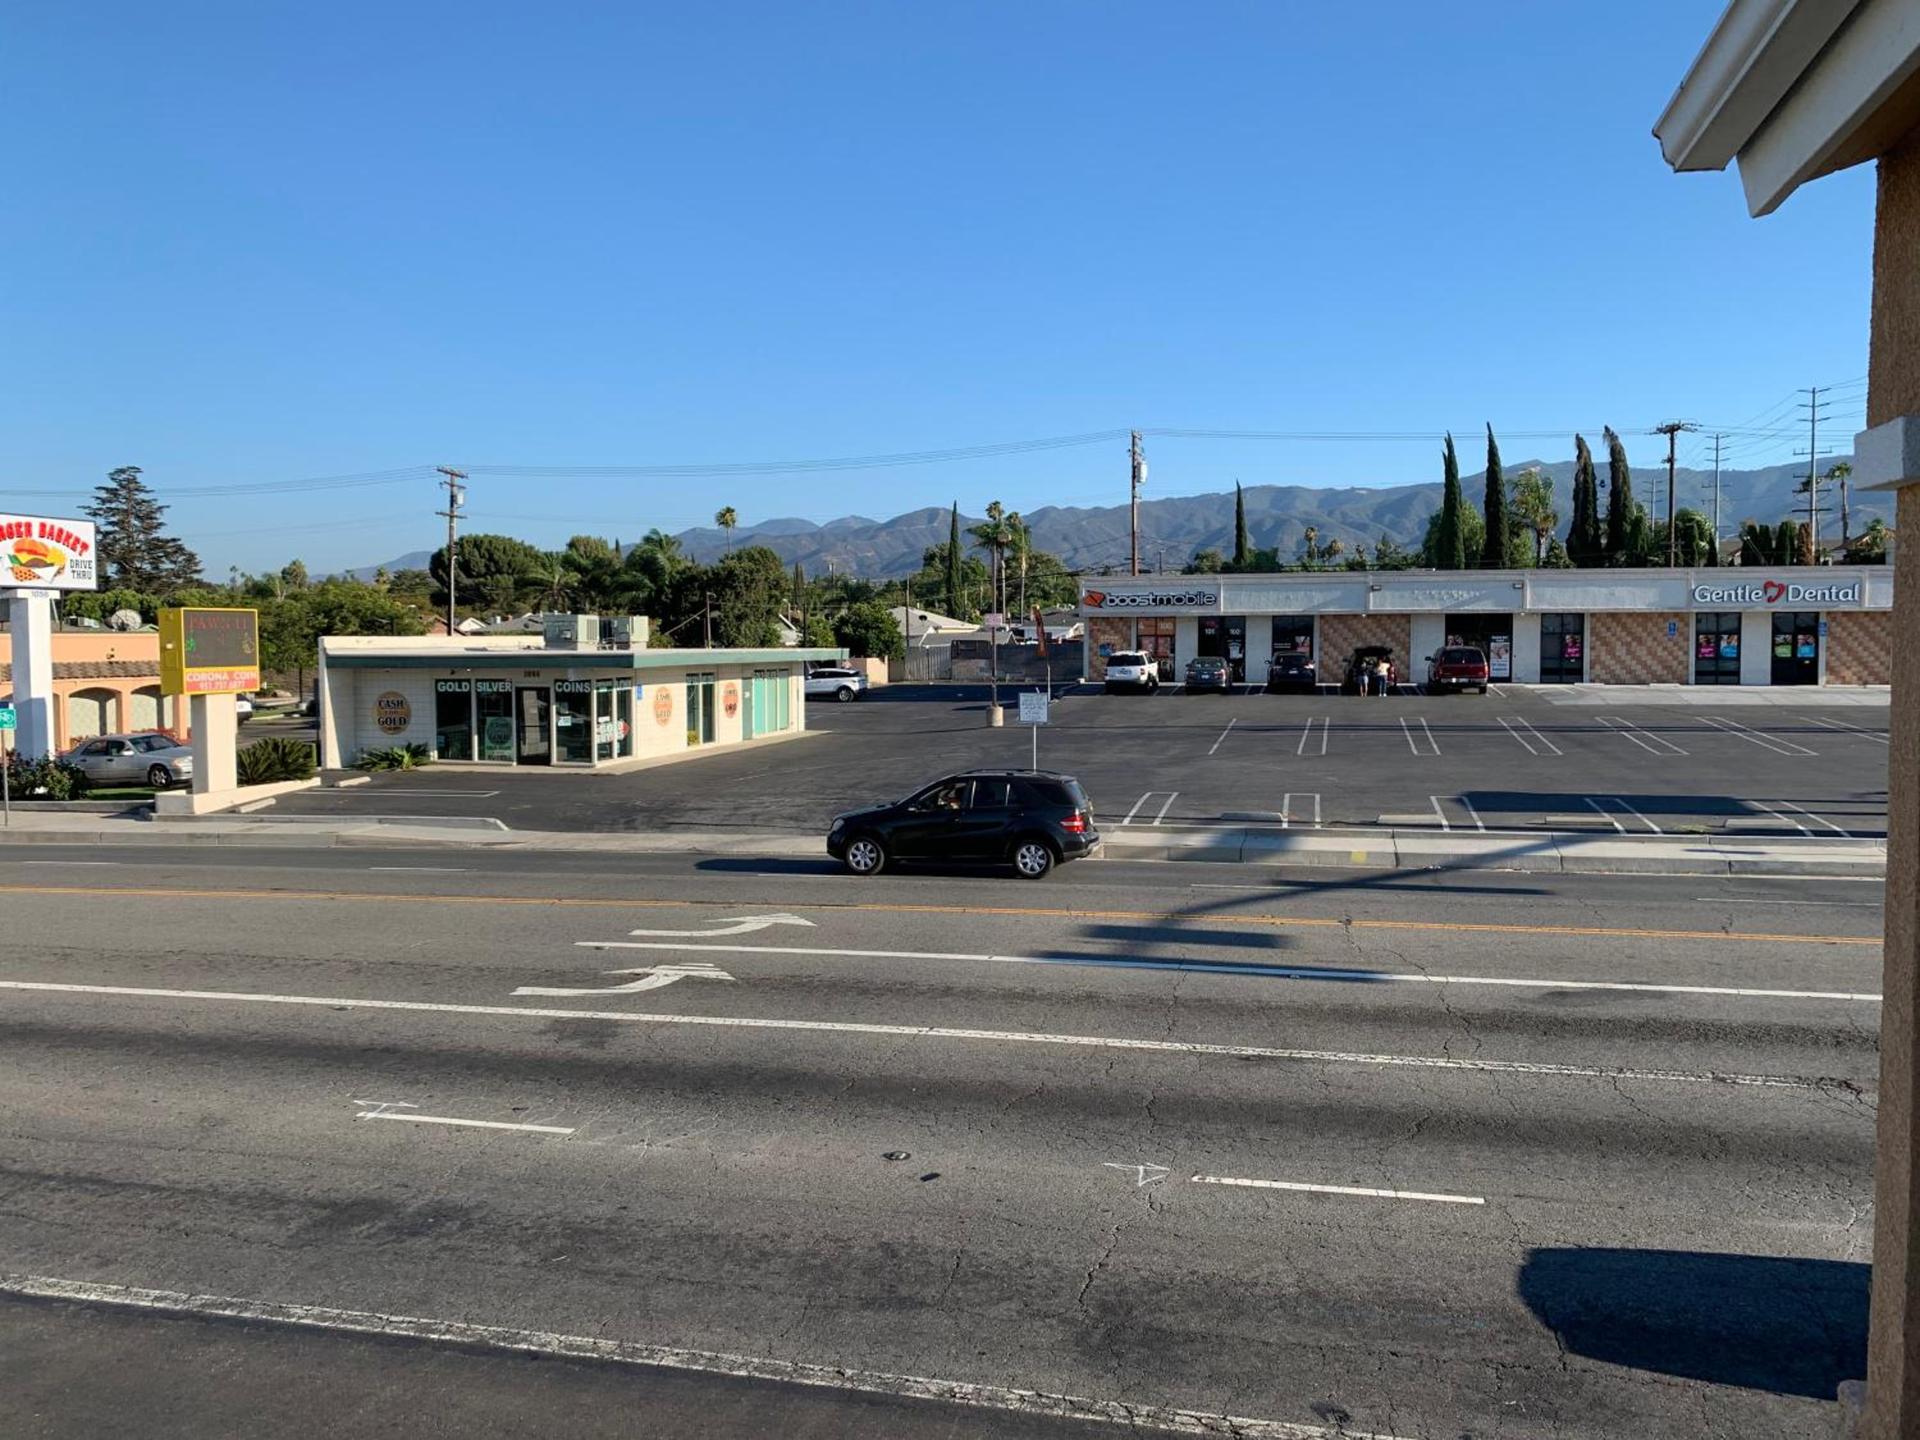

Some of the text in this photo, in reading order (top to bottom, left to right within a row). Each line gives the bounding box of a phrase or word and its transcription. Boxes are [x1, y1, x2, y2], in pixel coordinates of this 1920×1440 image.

[38, 521, 91, 557] BASKET
[69, 559, 93, 569] DRIVE
[71, 570, 92, 580] THRU
[1105, 591, 1217, 607] boostmobile
[1693, 583, 1860, 603] Gentle Dental
[186, 671, 229, 683] CORONA
[437, 681, 470, 692] GOLD
[476, 681, 513, 693] SILVER
[555, 681, 592, 693] COINS
[378, 699, 405, 709] CASH
[378, 717, 407, 727] GOLD
